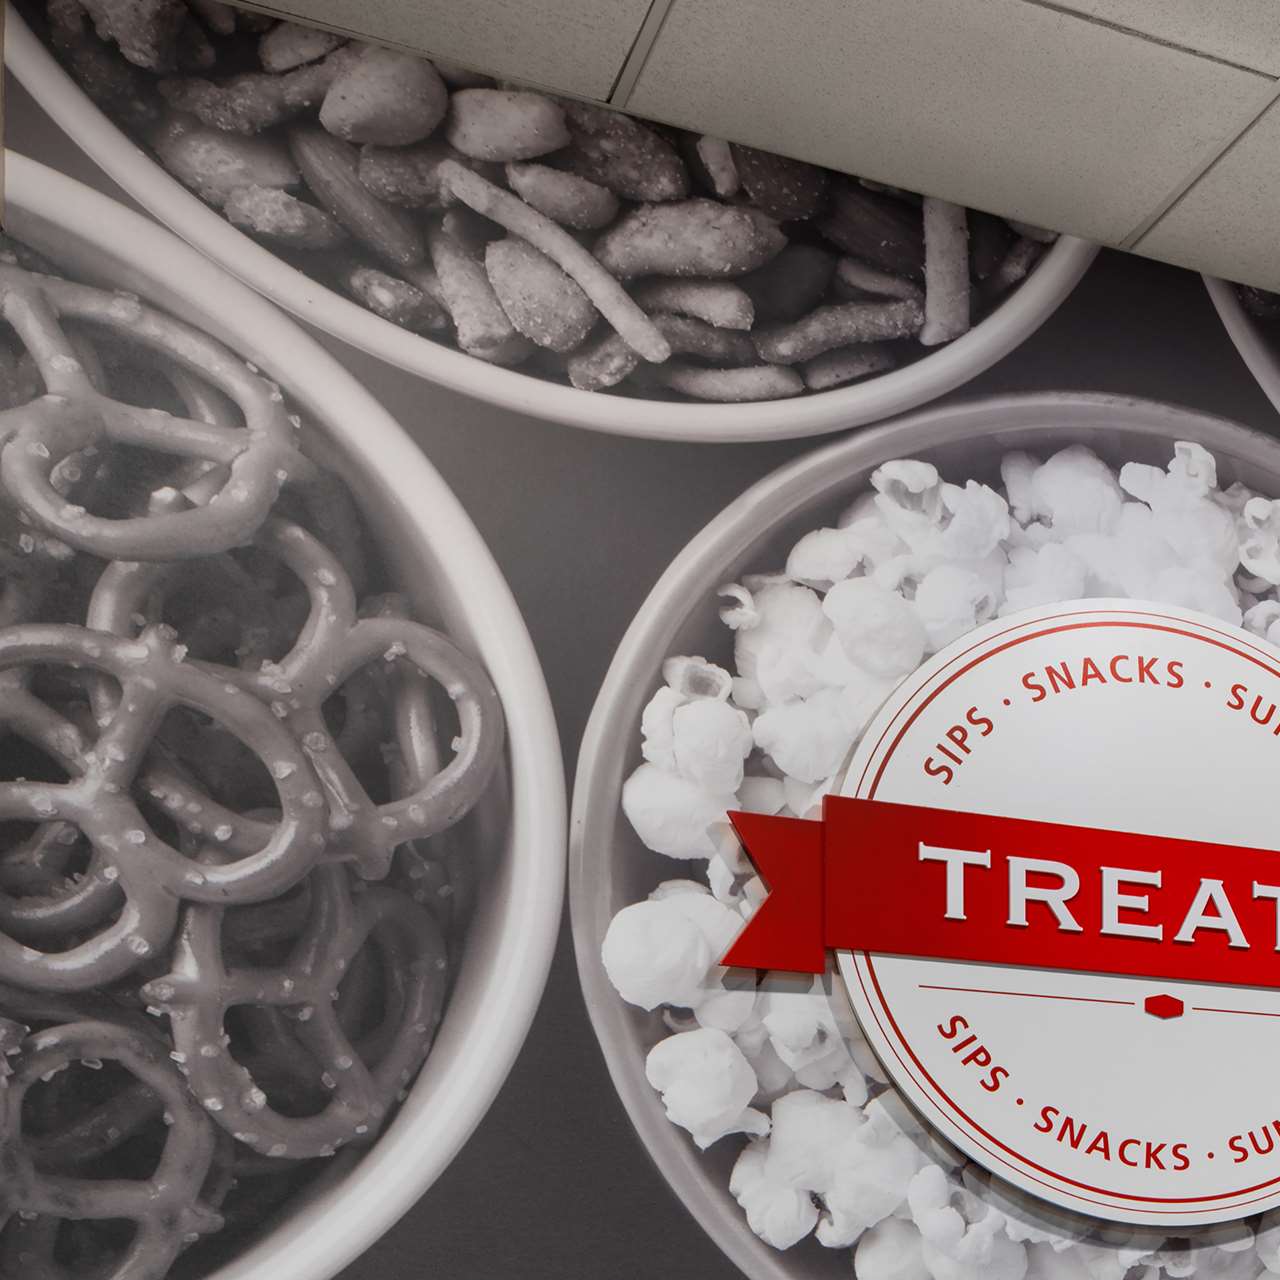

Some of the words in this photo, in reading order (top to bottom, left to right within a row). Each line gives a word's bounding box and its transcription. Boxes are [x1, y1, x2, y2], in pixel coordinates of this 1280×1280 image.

[922, 702, 997, 787] SIPS
[1020, 653, 1187, 705] SNACKS
[935, 1013, 1007, 1095] SIPS
[1031, 1102, 1192, 1172] SNACKS
